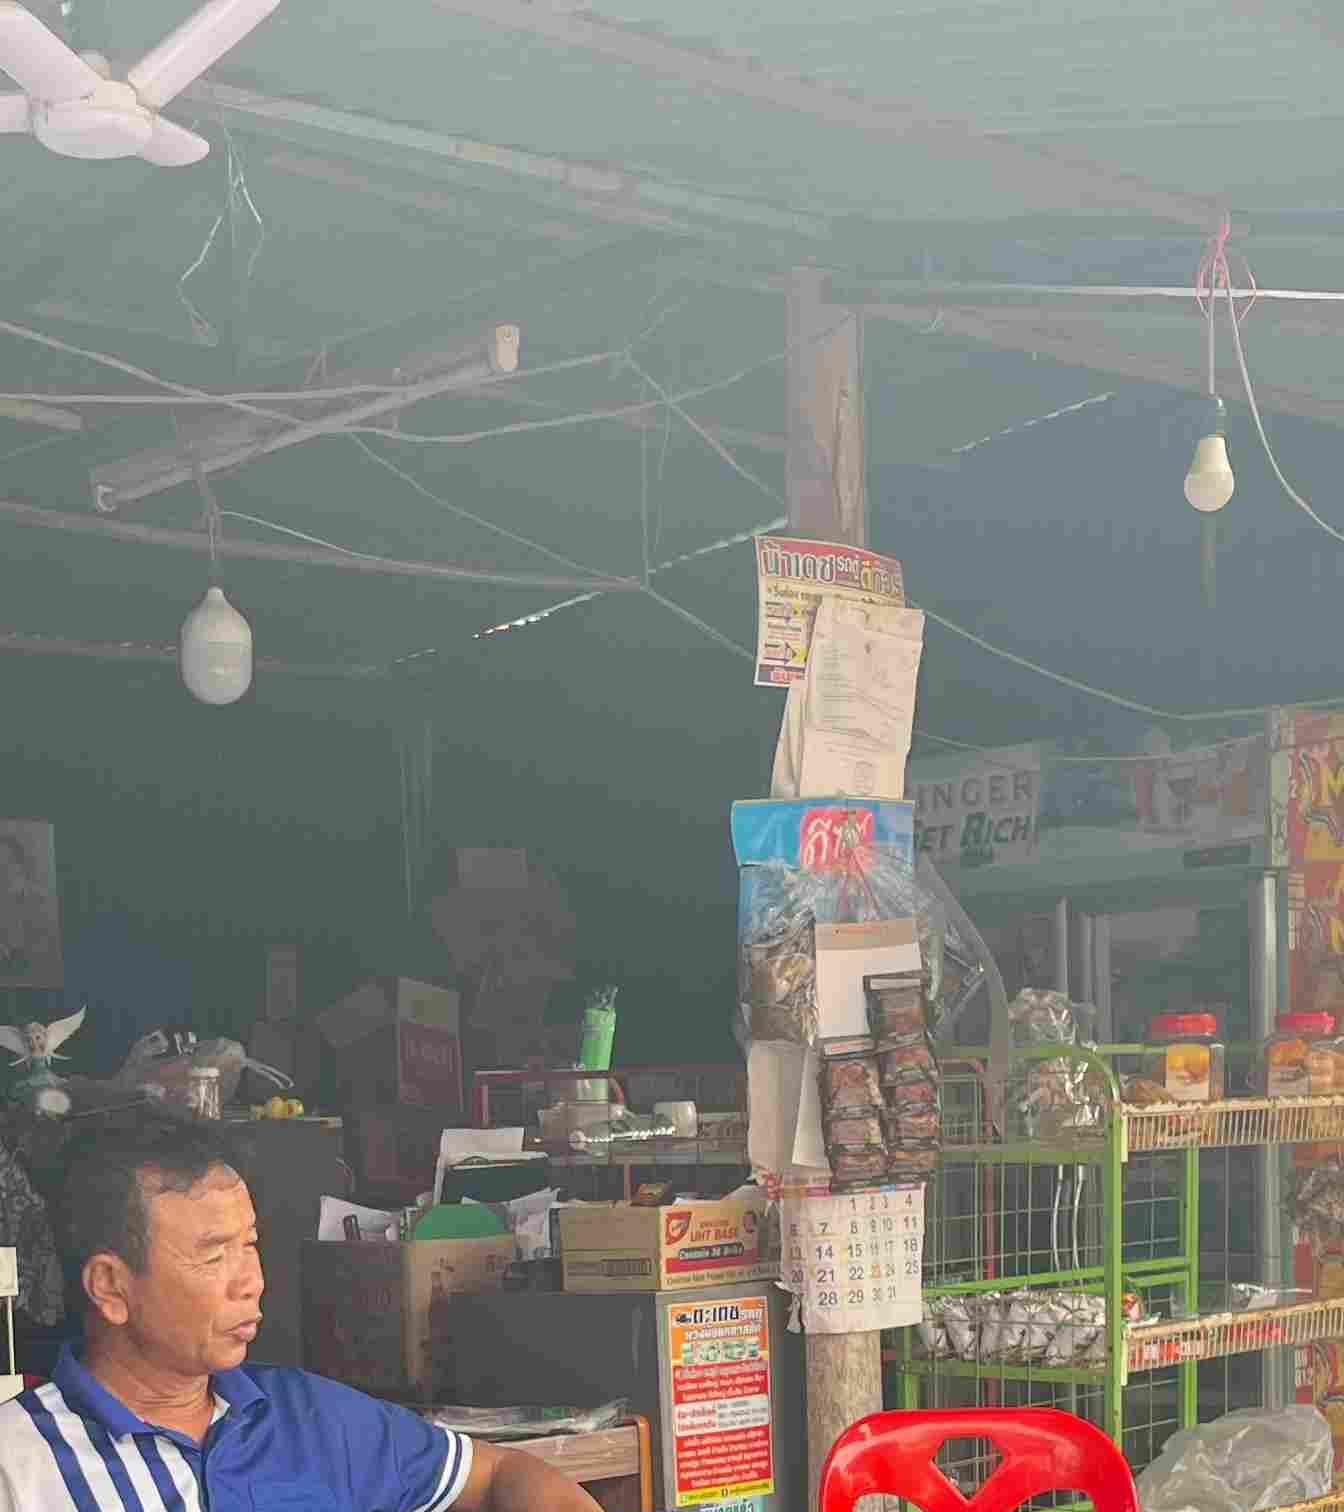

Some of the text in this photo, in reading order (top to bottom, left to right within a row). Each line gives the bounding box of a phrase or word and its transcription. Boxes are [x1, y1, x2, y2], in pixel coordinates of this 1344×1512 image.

[816, 1245, 834, 1260] 14
[848, 1243, 864, 1258] 15
[817, 1269, 835, 1282] 21
[848, 1266, 864, 1280] 22
[817, 1291, 838, 1305] 28
[847, 1289, 864, 1303] 29
